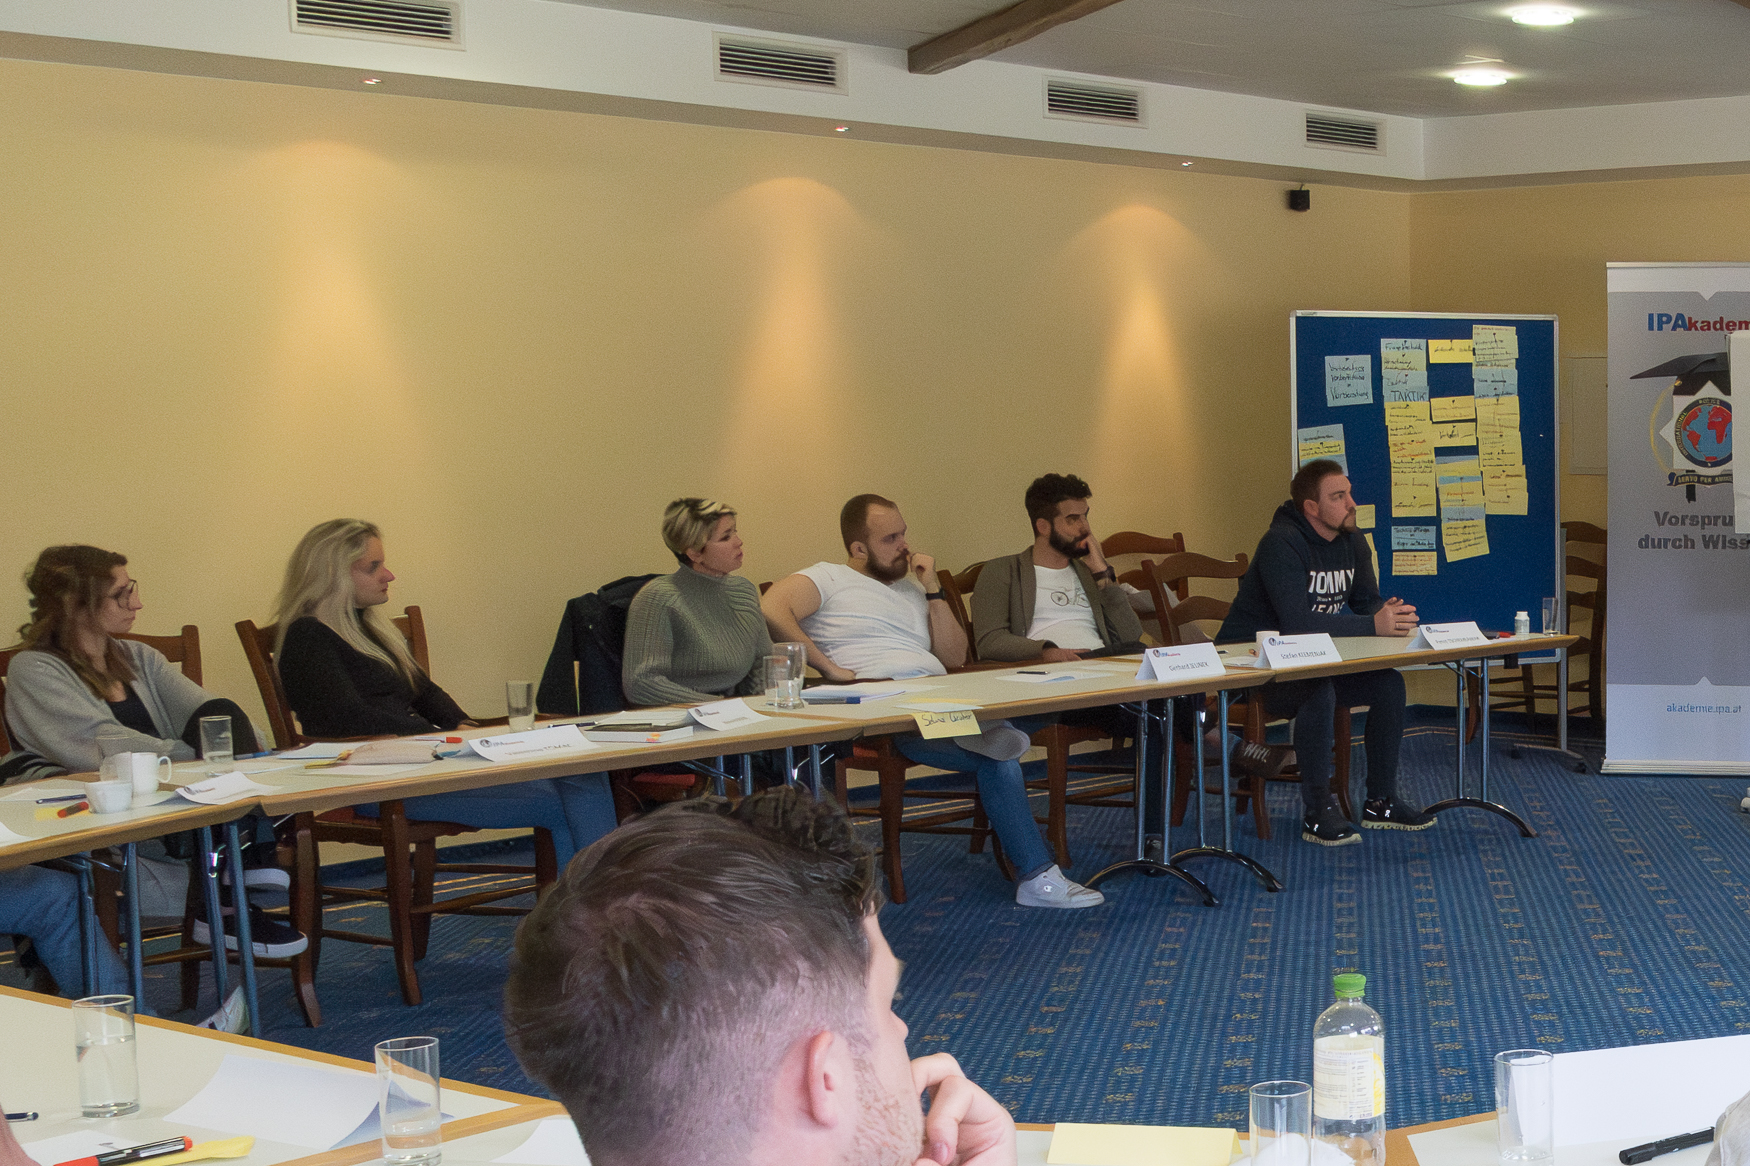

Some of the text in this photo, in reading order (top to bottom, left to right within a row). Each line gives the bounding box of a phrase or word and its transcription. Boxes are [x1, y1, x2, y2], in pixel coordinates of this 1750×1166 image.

[1654, 511, 1735, 530] Vorspru
[1638, 534, 1750, 550] durch Wiss
[1308, 568, 1355, 594] TOMMY
[1666, 703, 1742, 714] akademie.ipa.at
